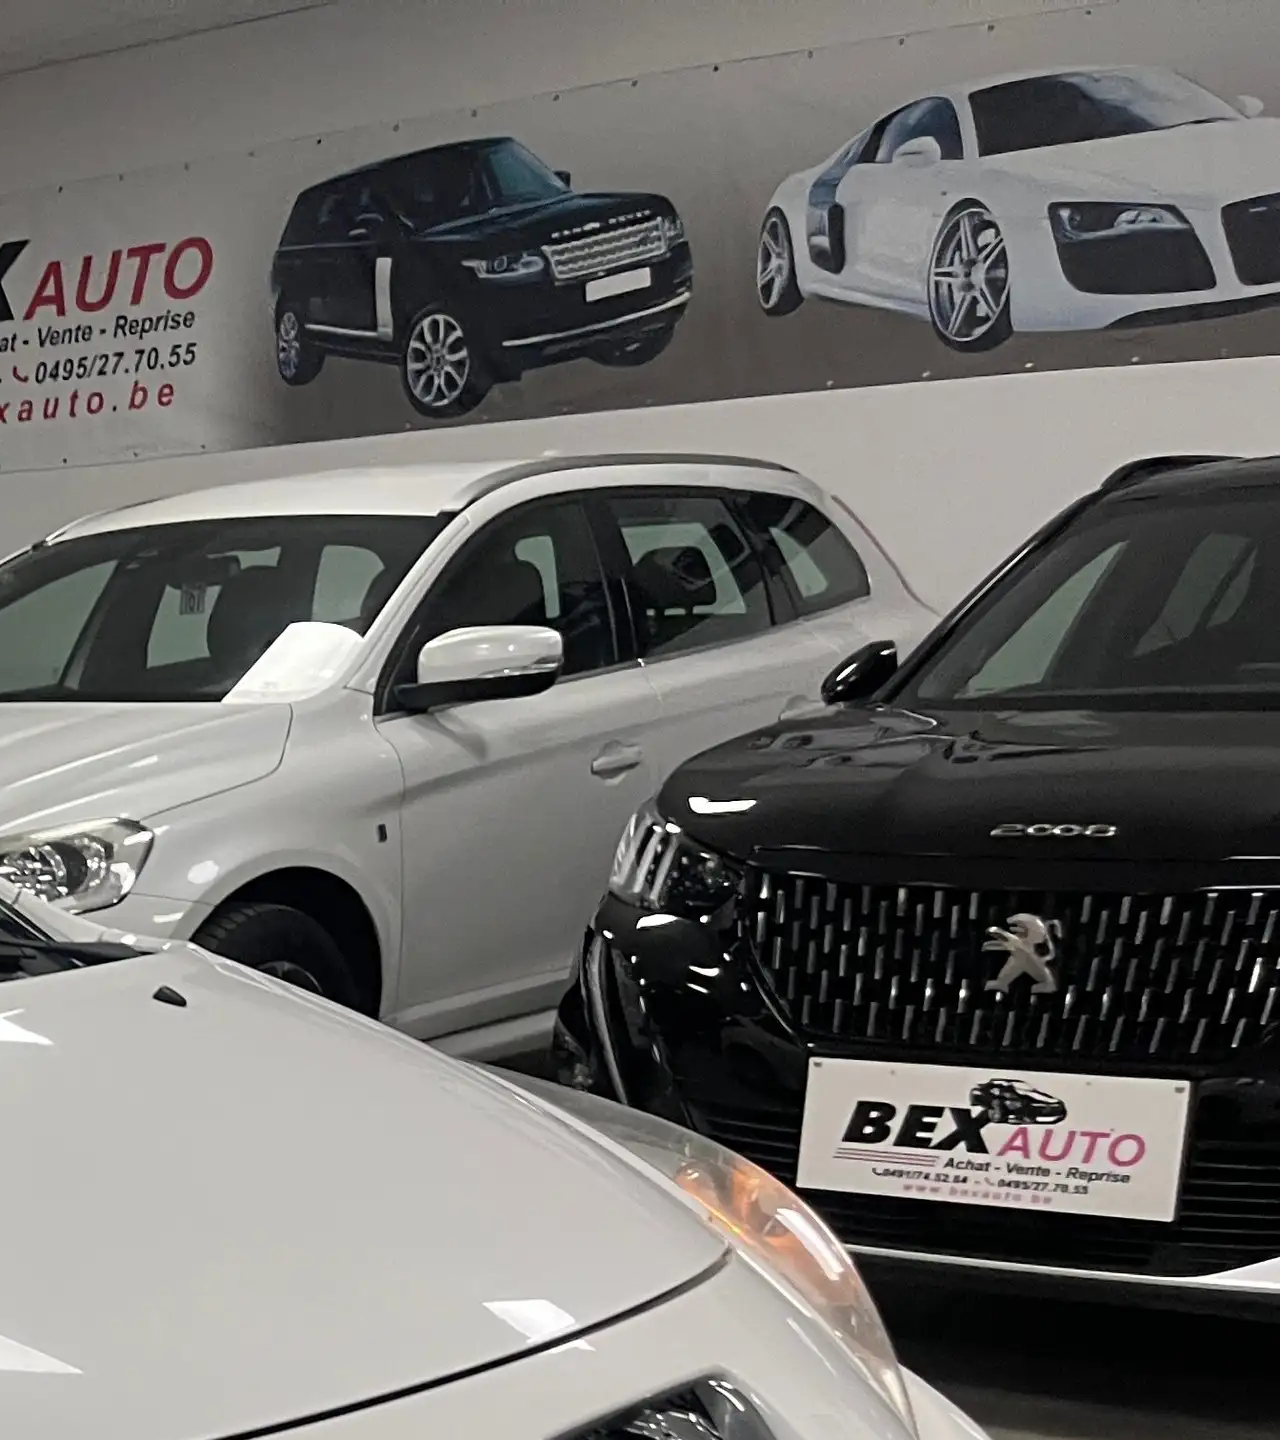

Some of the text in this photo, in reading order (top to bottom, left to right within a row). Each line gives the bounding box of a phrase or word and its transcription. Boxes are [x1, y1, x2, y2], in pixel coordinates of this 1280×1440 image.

[23, 236, 213, 321] AUTO
[37, 324, 93, 348] Vente
[113, 309, 196, 340] Reprise
[35, 342, 198, 384] 0495/27.70.55
[842, 1100, 1147, 1167] BEX AUTO
[943, 1158, 992, 1172] Achat
[1006, 1162, 1051, 1177] Vente
[1065, 1167, 1131, 1183] Reprise
